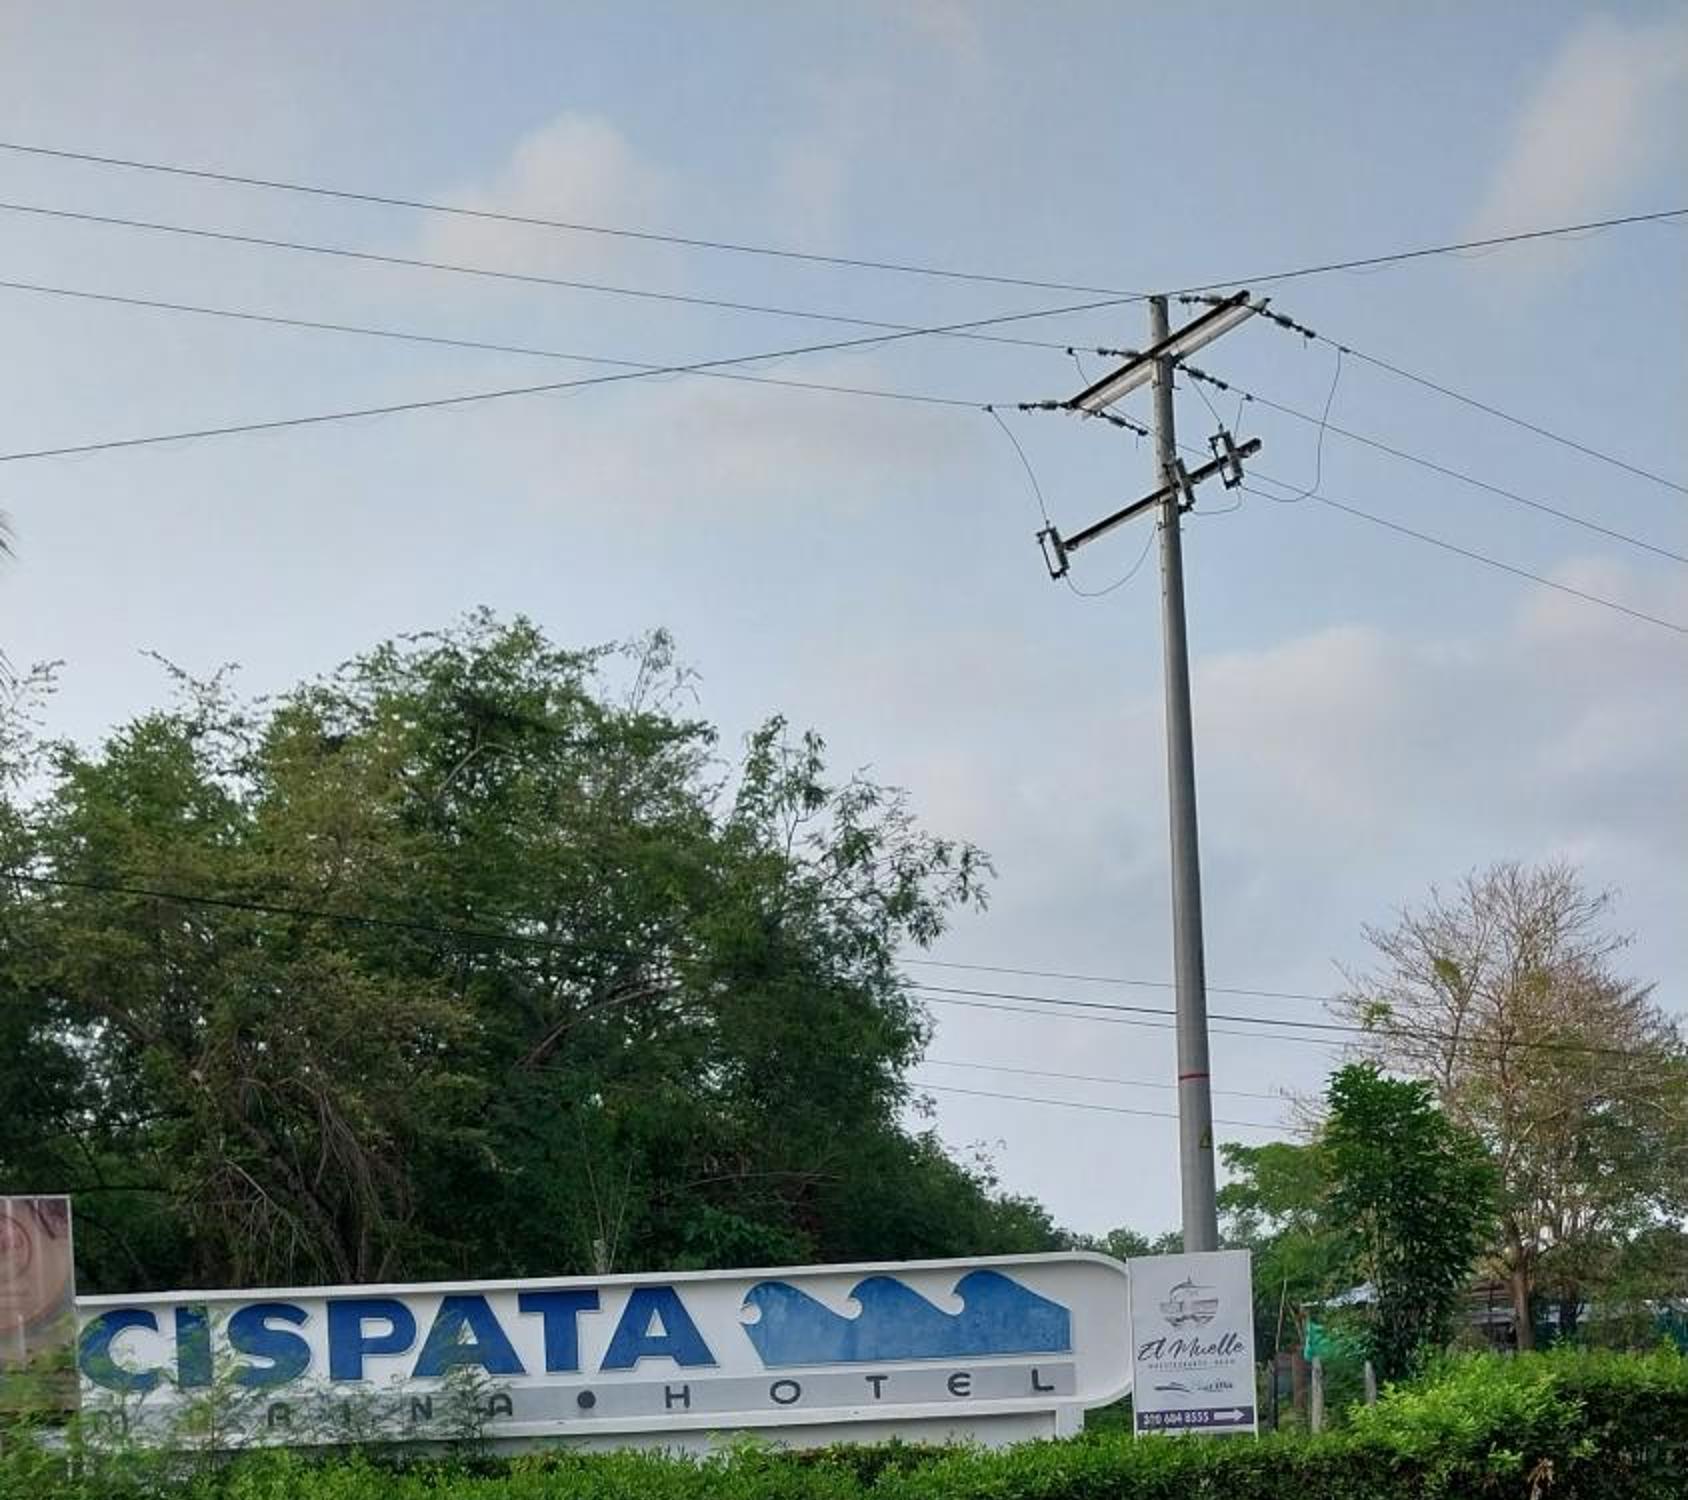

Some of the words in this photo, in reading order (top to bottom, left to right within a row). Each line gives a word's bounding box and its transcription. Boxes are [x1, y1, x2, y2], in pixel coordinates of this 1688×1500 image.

[79, 1286, 718, 1391] CISPATA
[1169, 1331, 1245, 1361] Muelle
[94, 1393, 514, 1432] MRINA
[665, 1369, 1055, 1409] HOTEL
